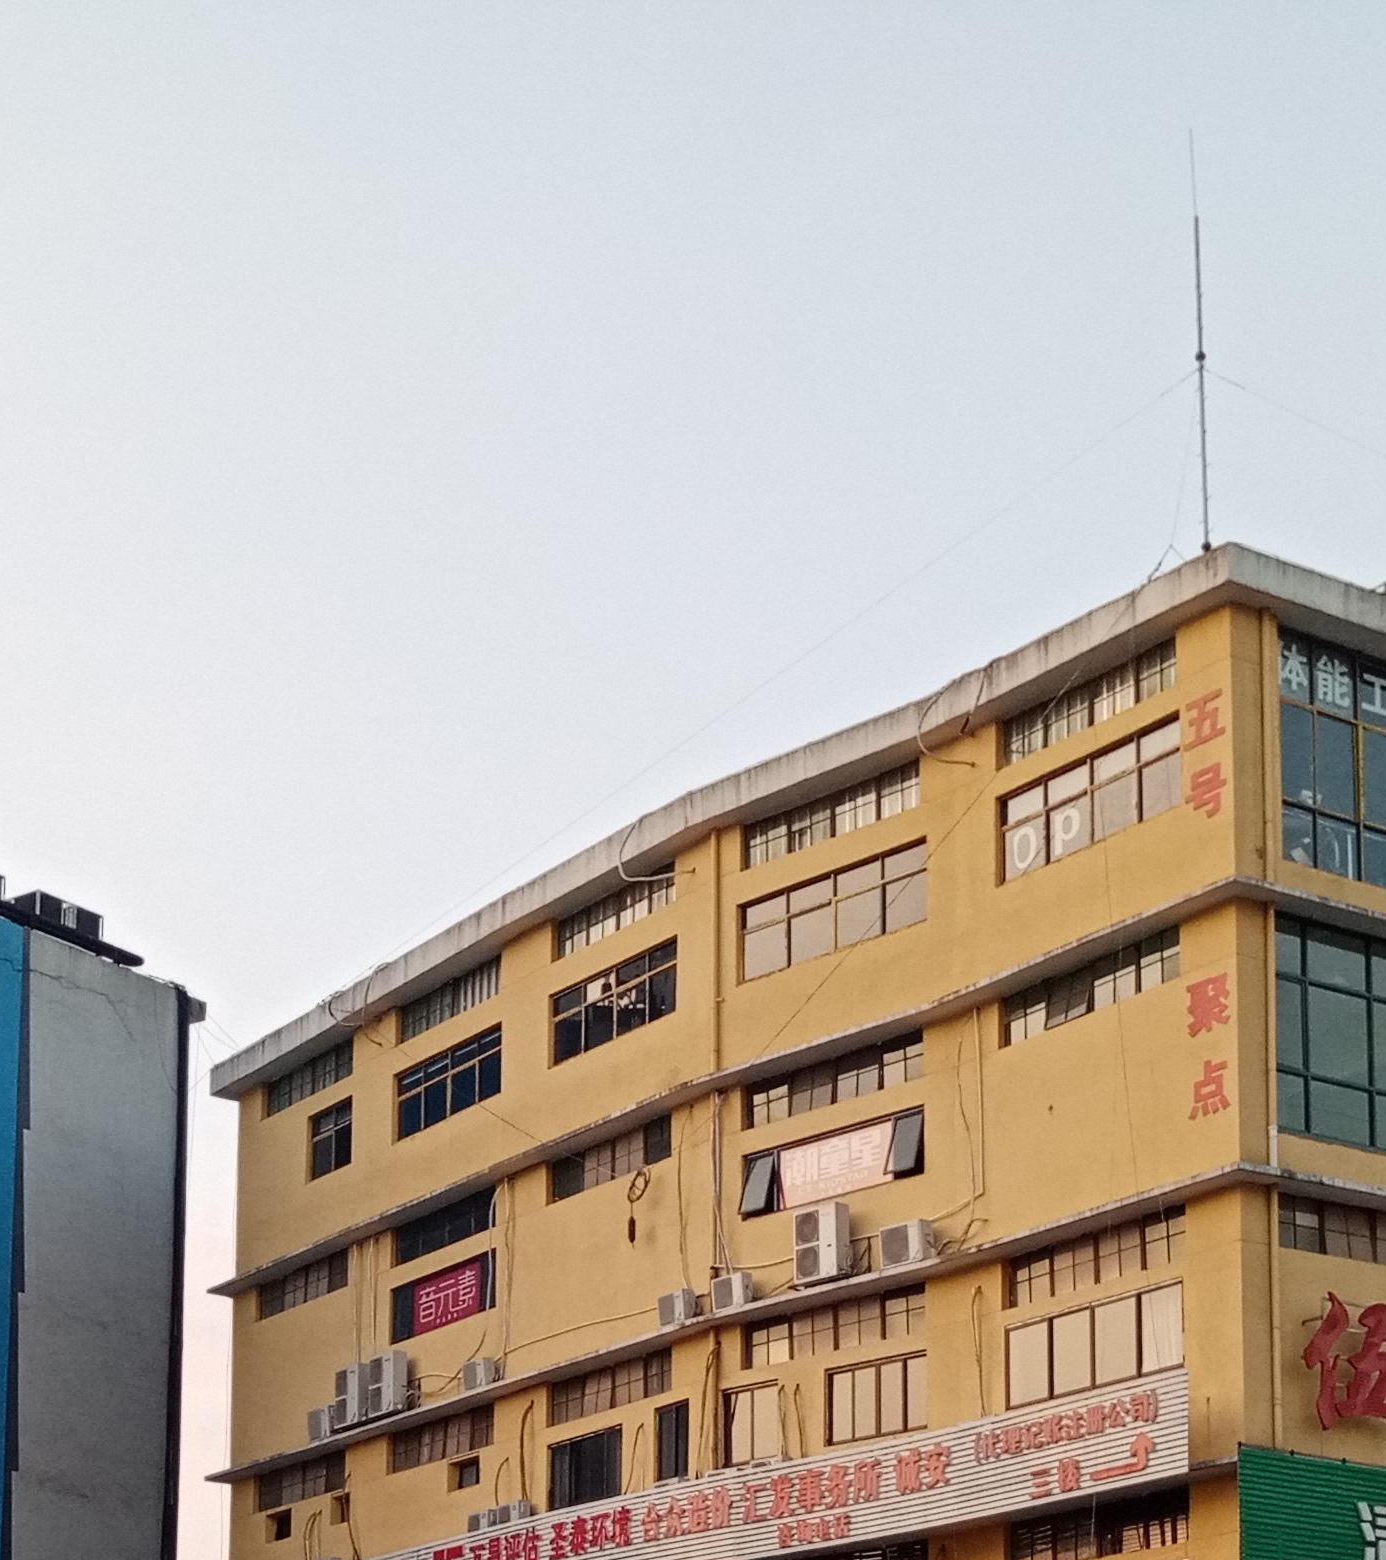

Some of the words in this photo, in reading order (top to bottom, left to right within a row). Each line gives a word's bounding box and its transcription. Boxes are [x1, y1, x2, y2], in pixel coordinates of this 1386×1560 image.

[1184, 689, 1231, 1120] 五号聚点
[419, 1270, 476, 1323] 音元素
[549, 1506, 632, 1560] 圣泰环境
[741, 1457, 882, 1524] 汇发事务所
[894, 1443, 950, 1494] 诚安
[1029, 1458, 1081, 1499] 三楼
